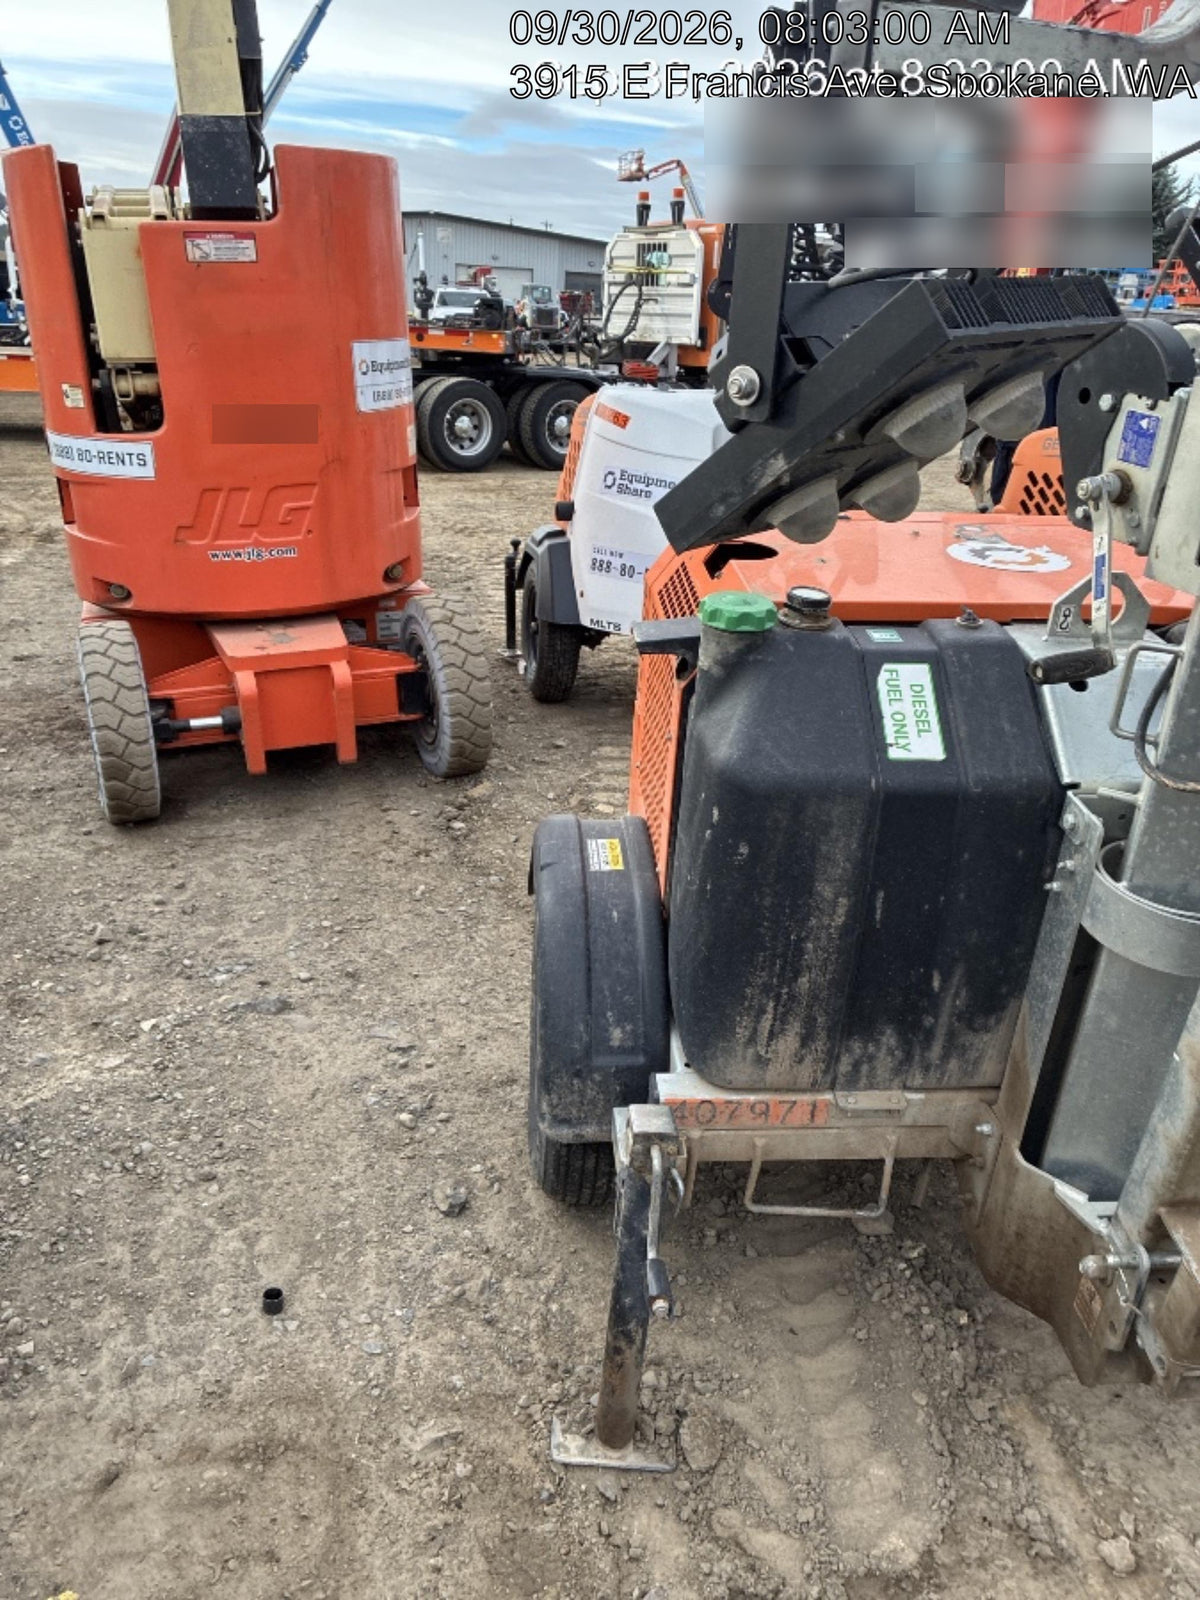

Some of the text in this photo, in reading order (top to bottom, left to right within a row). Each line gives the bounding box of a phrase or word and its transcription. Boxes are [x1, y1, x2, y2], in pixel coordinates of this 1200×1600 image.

[76, 447, 147, 467] 80-RENTS
[174, 482, 319, 545] JLG
[209, 547, 297, 561] www.jlg.com
[884, 668, 912, 753] FUEL ONLY
[909, 684, 932, 738] DIESEL
